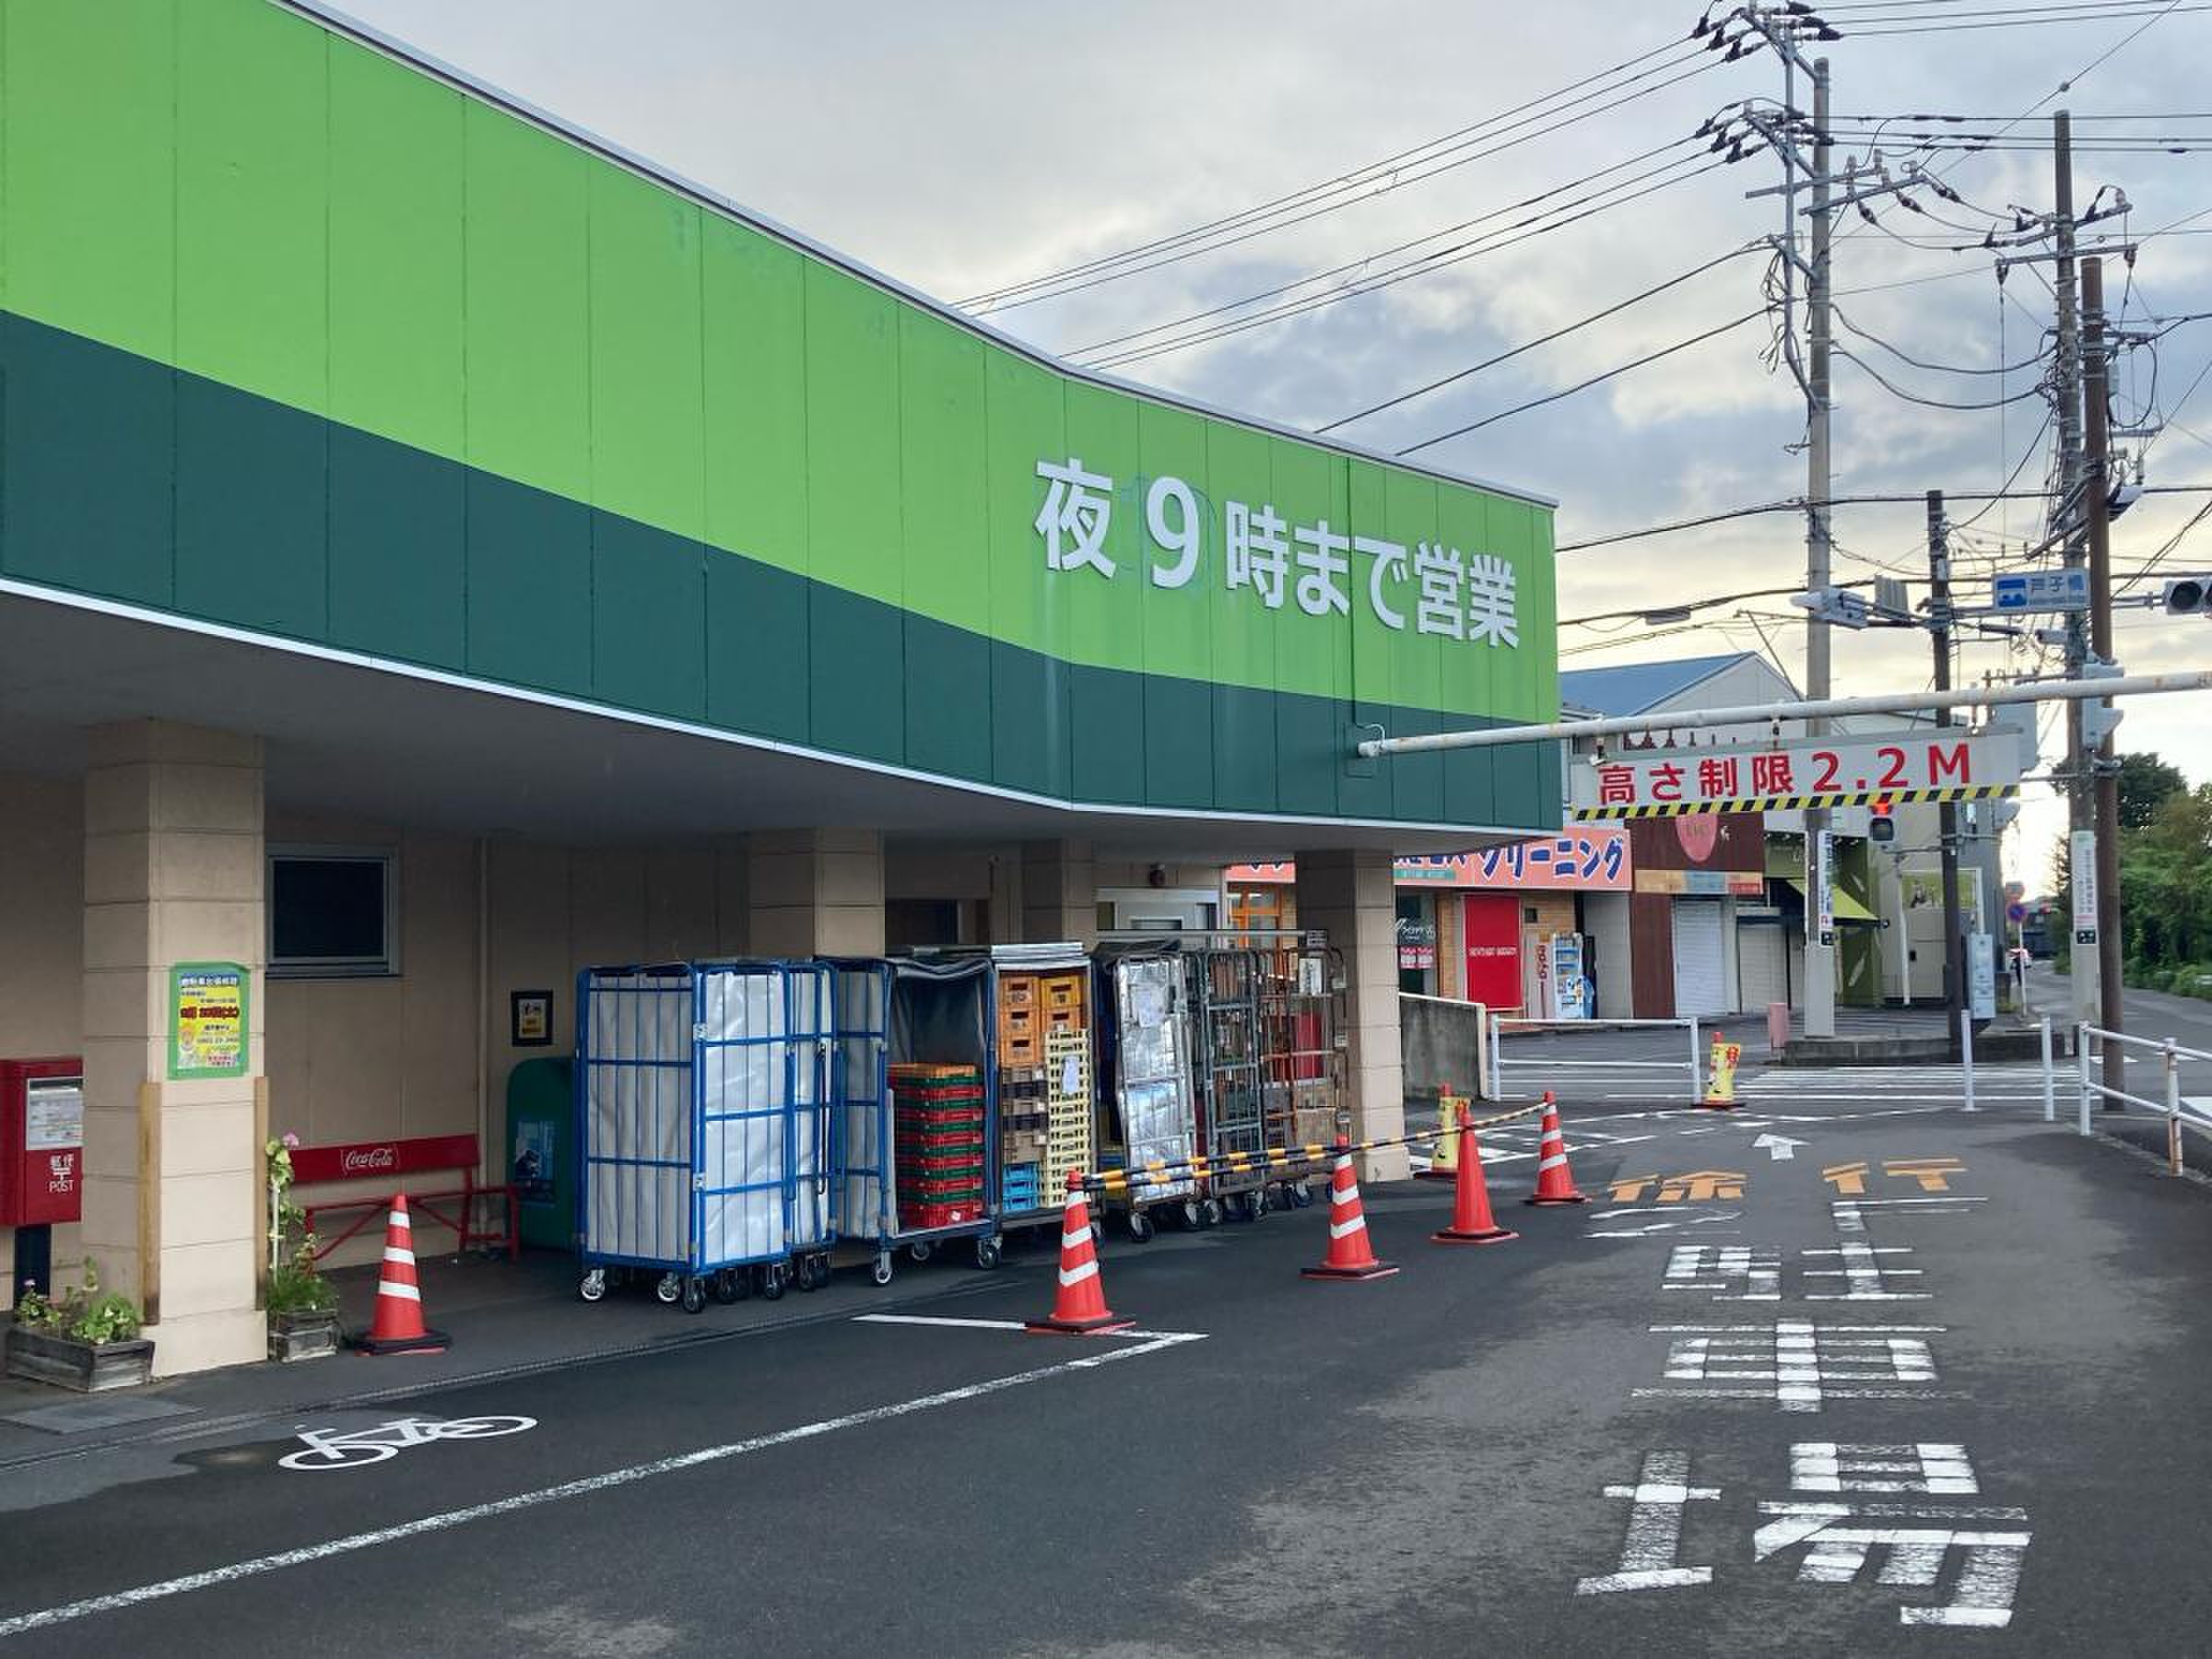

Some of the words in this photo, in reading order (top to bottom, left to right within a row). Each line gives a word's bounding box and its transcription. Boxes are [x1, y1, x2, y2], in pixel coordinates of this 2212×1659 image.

[1033, 458, 1520, 649] 夜9時まで営業
[1598, 742, 1971, 806] 高さ制限2.2M
[49, 1179, 75, 1194] POST
